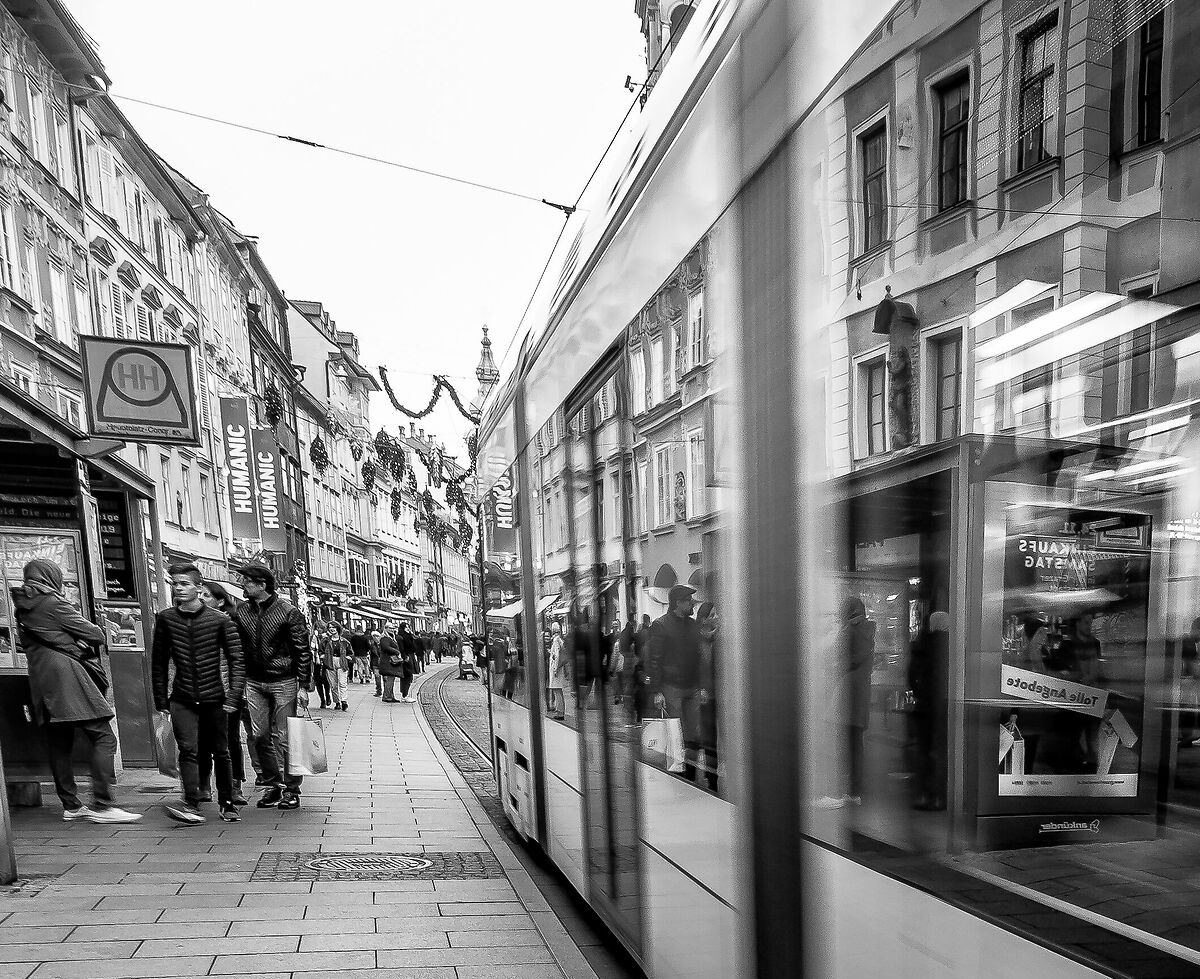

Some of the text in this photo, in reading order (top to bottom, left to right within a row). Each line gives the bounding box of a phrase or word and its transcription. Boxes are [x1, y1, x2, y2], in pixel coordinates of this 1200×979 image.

[118, 363, 159, 391] HH
[227, 424, 253, 513] HUMANIC
[257, 451, 280, 529] HUMANIC
